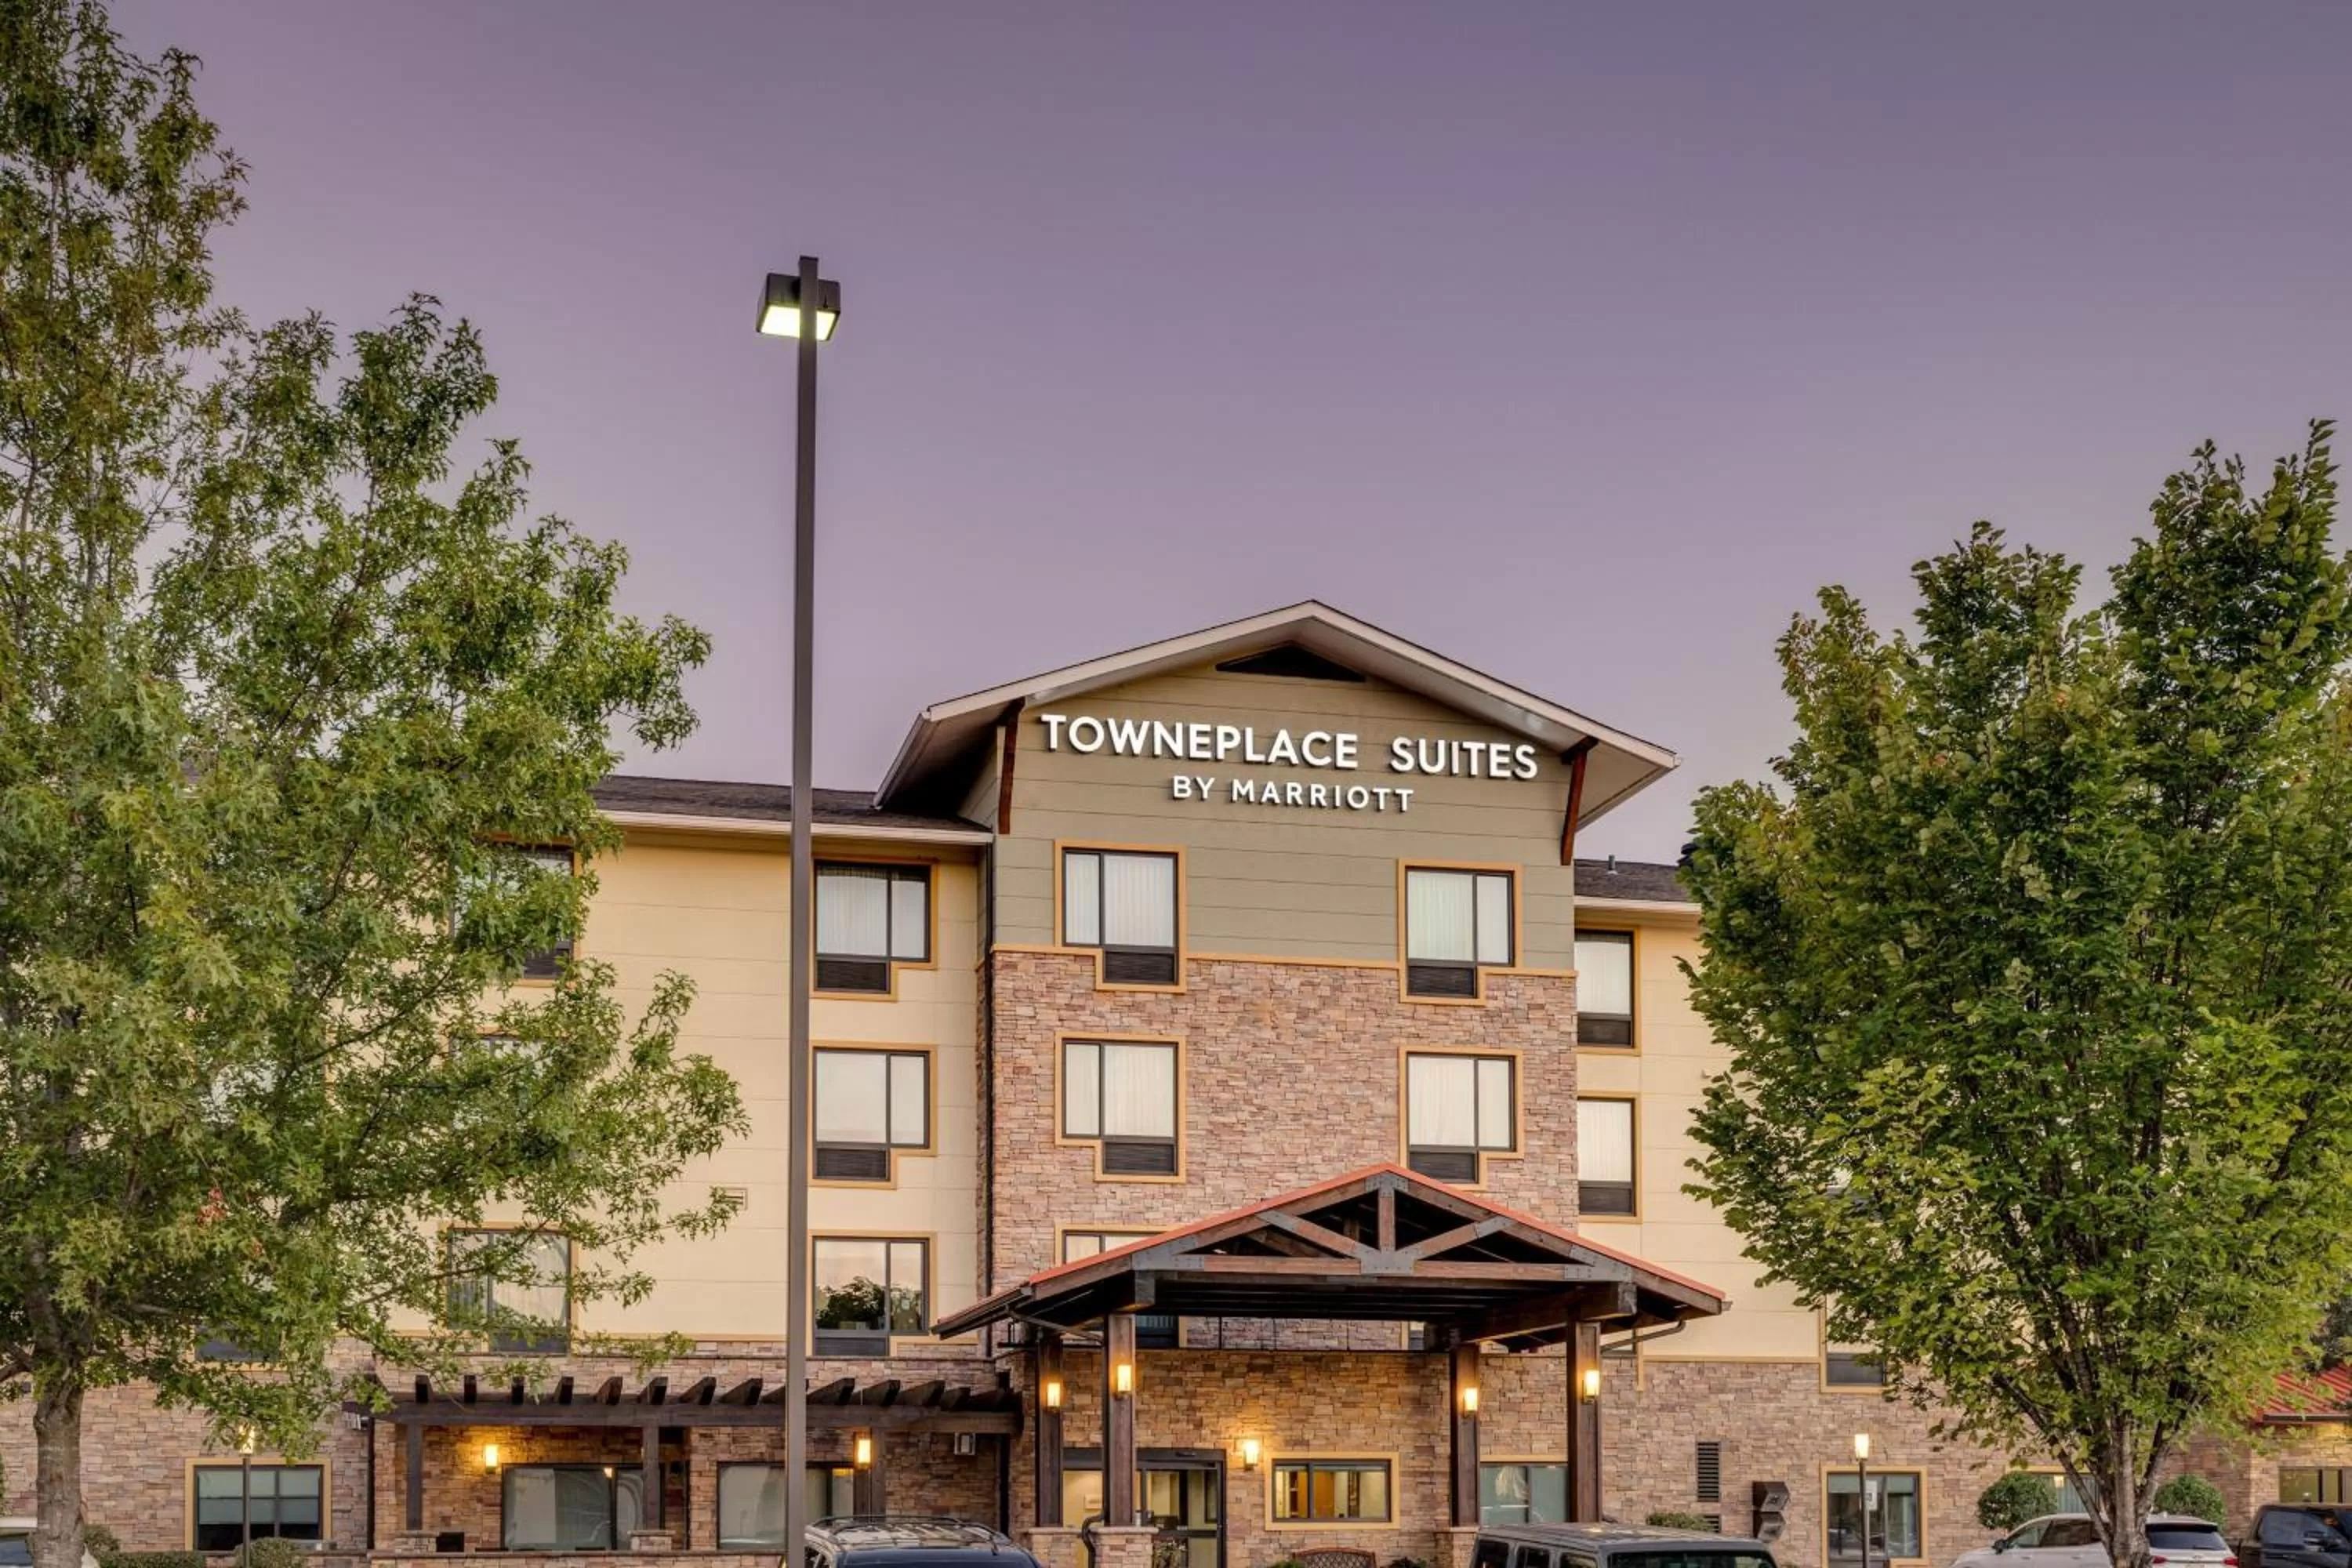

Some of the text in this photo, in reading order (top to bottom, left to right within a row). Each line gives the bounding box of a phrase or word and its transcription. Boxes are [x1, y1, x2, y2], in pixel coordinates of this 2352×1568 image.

[1040, 713, 1539, 780] TOWNEPLACE SUITES
[1172, 774, 1414, 813] BY MARRIOTT
